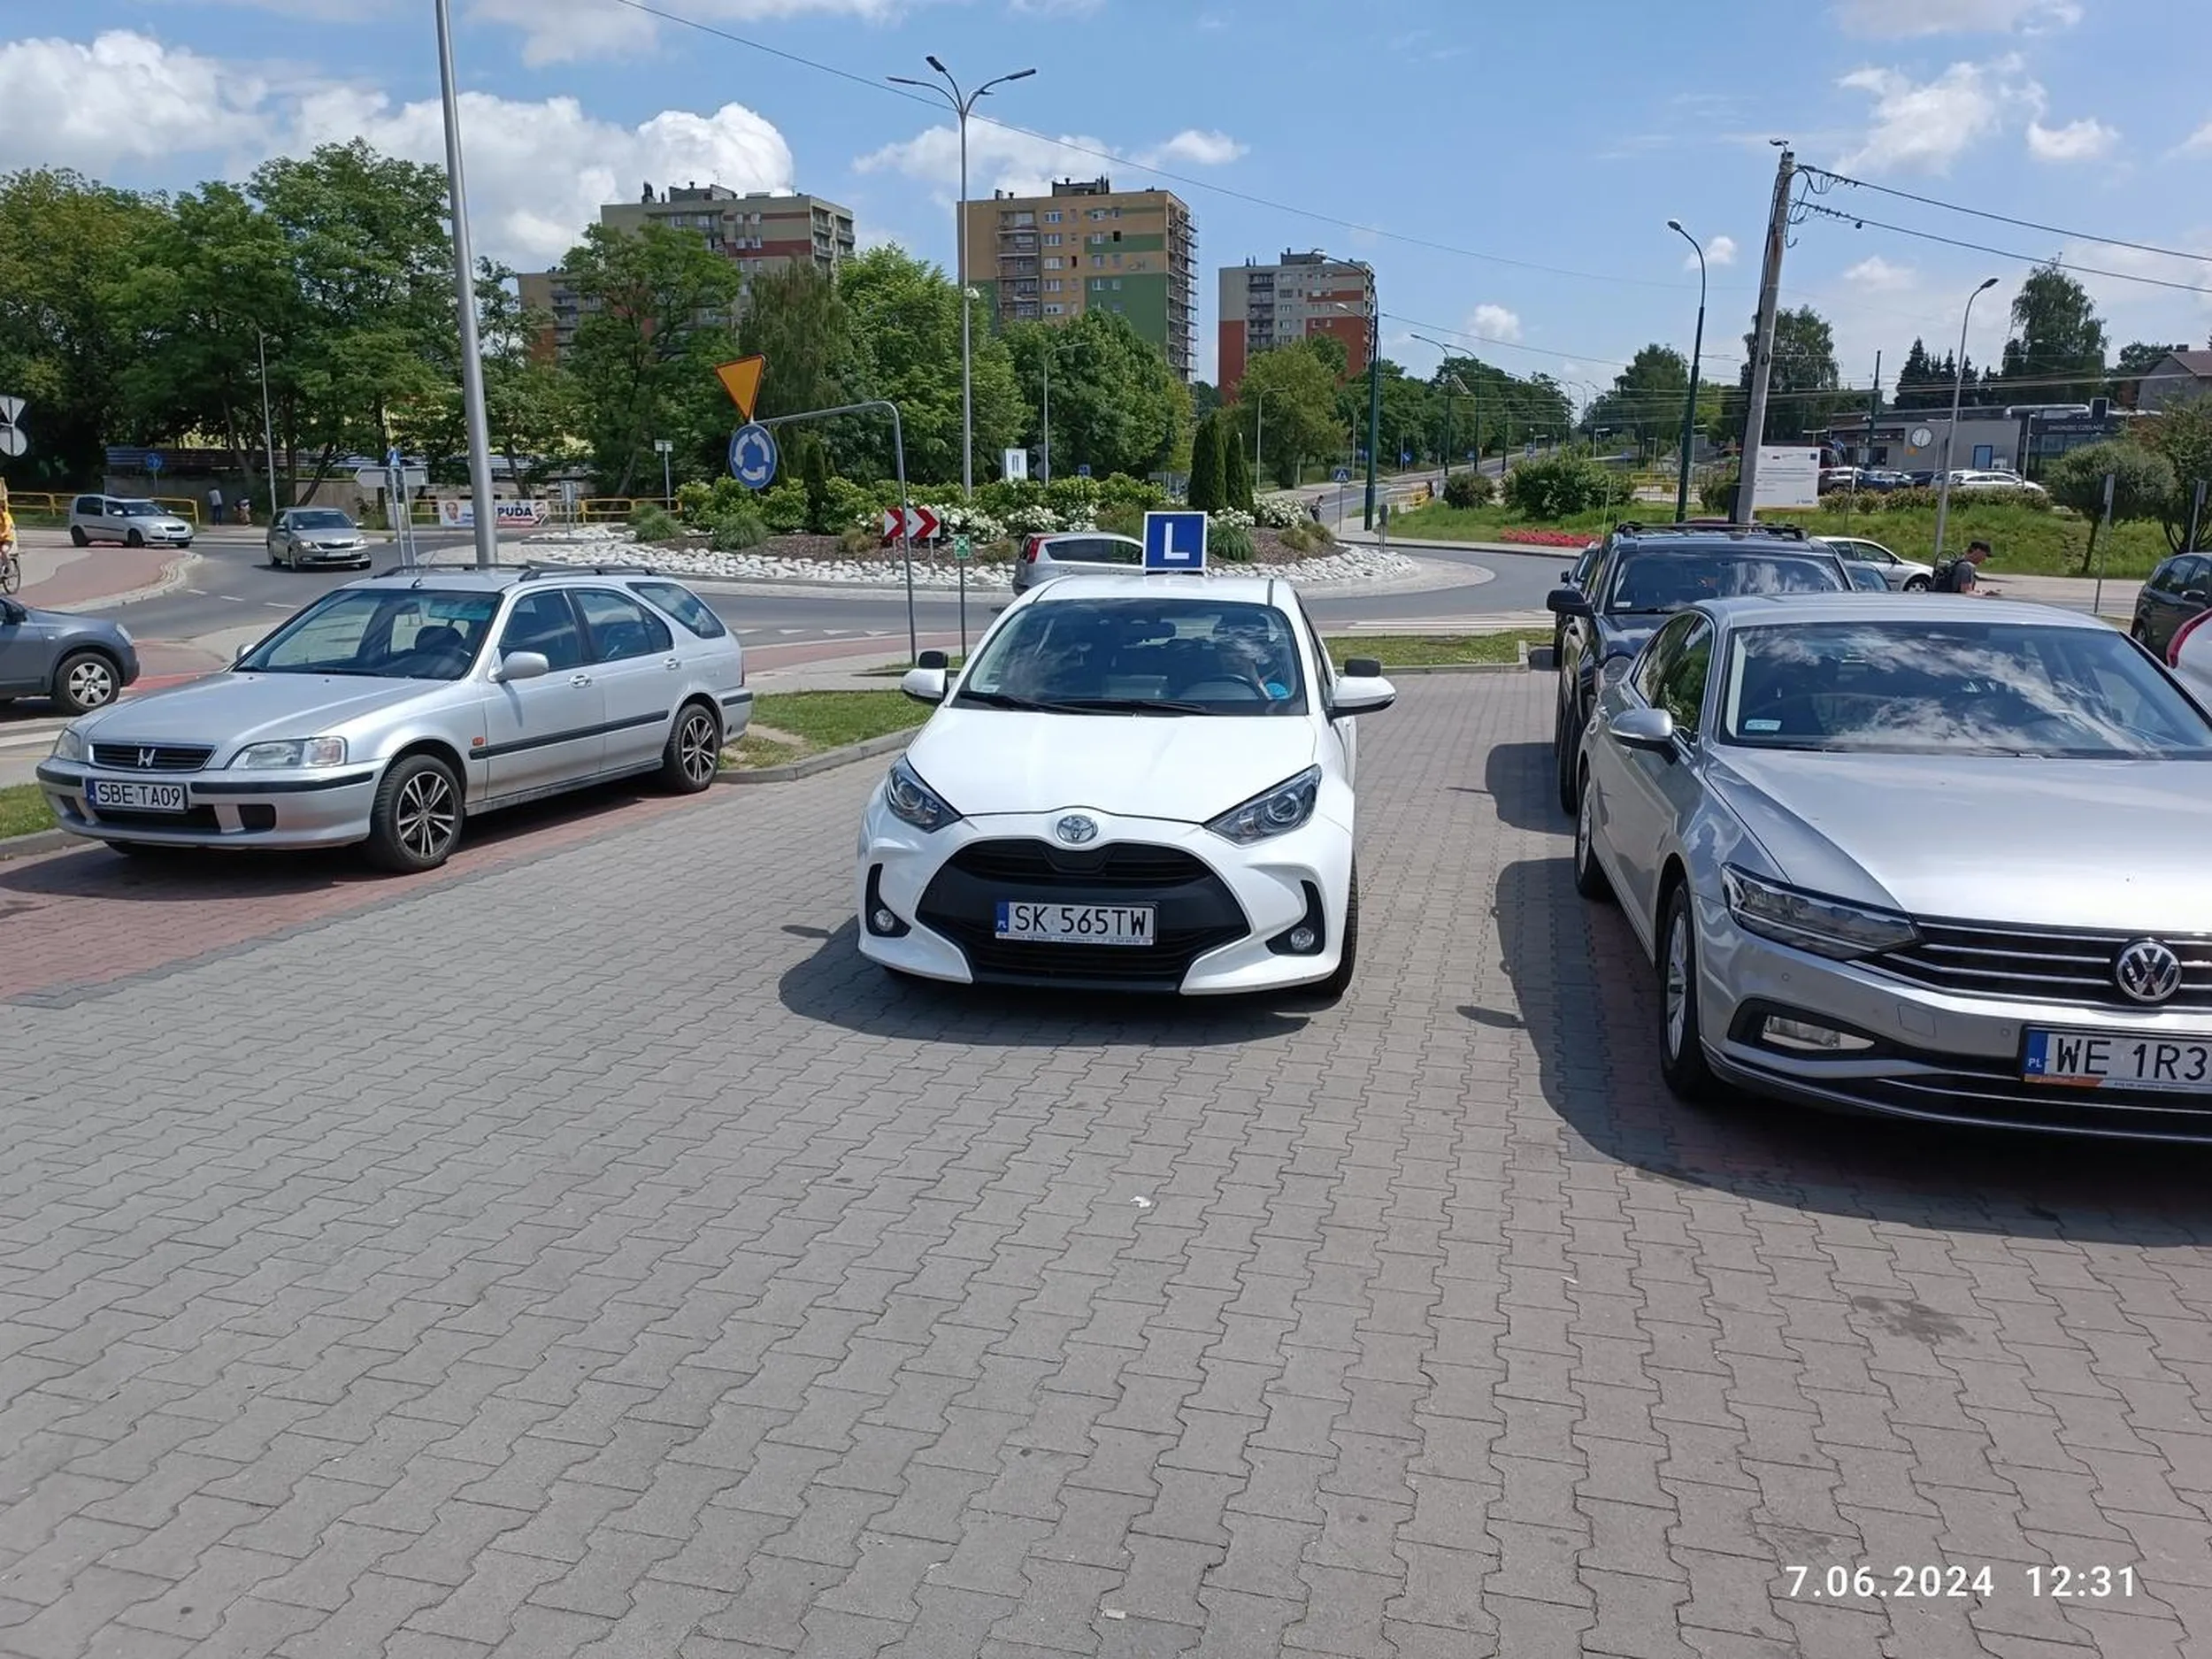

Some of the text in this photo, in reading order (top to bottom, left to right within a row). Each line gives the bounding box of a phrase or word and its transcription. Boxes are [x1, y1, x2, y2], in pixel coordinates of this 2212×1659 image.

[497, 507, 533, 517] PUDA
[1164, 522, 1189, 559] L
[98, 784, 180, 807] SBE TA09
[1015, 906, 1147, 936] SK 565TW
[2028, 1057, 2042, 1068] PL
[2056, 1037, 2212, 1081] WE 1R3
